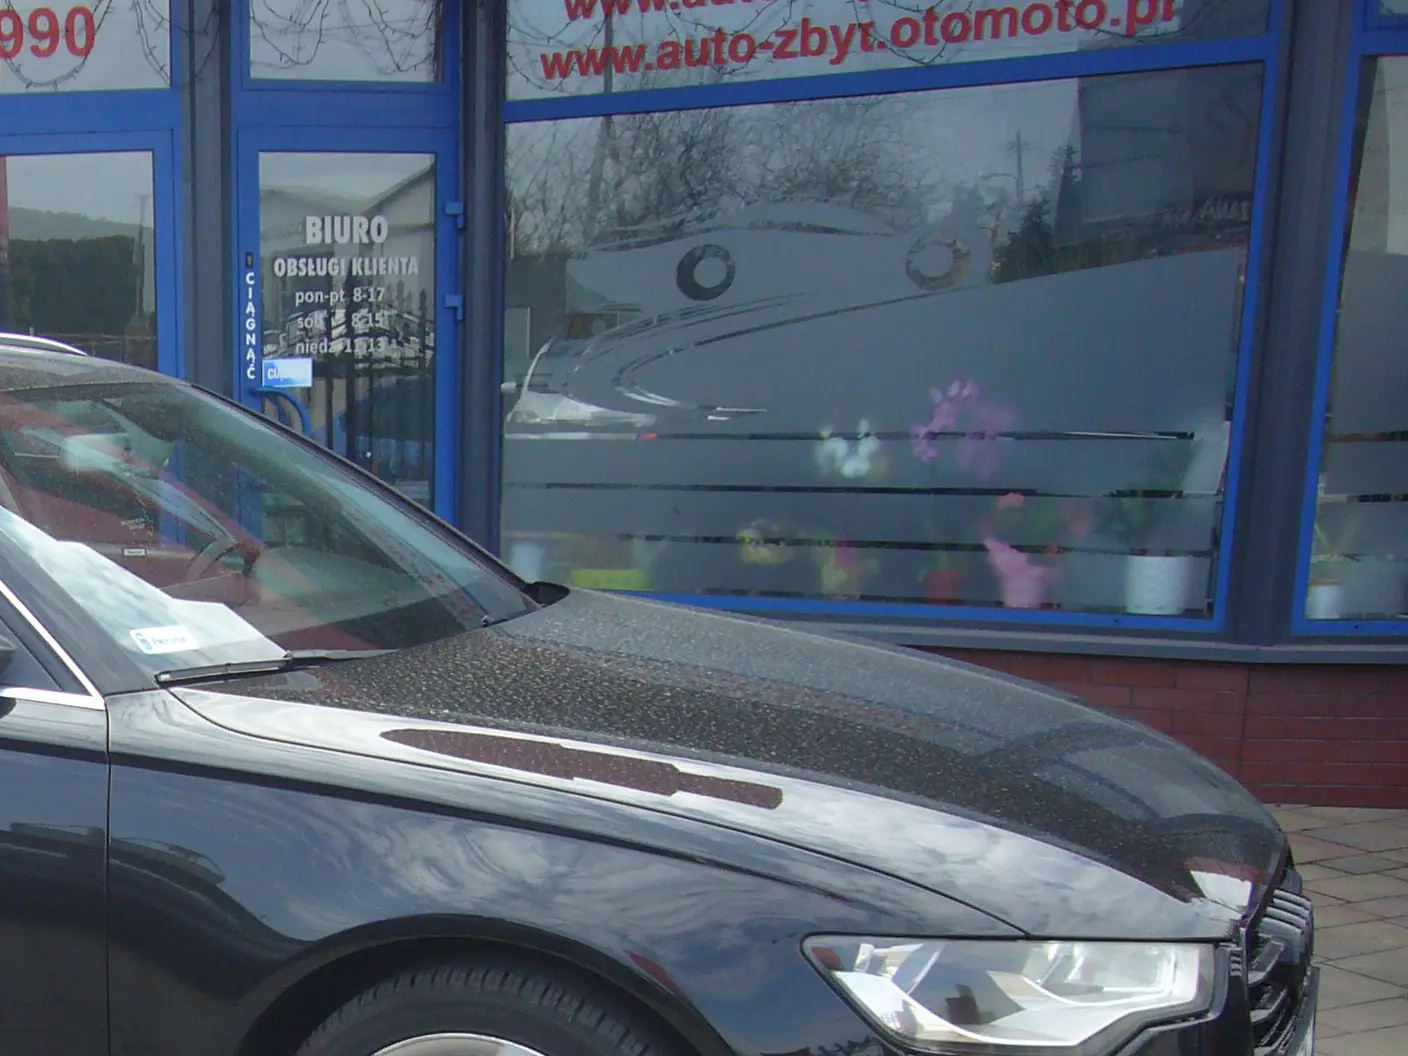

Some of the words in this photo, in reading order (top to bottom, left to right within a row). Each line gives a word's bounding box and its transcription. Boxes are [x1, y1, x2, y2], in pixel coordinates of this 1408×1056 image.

[306, 215, 388, 244] BIURO
[274, 257, 346, 277] OBSŁUGI
[352, 256, 418, 276] KLIENTA
[295, 288, 345, 306] pon-pt
[353, 287, 385, 302] 8-17
[245, 272, 256, 379] CIĄGNĄĆ
